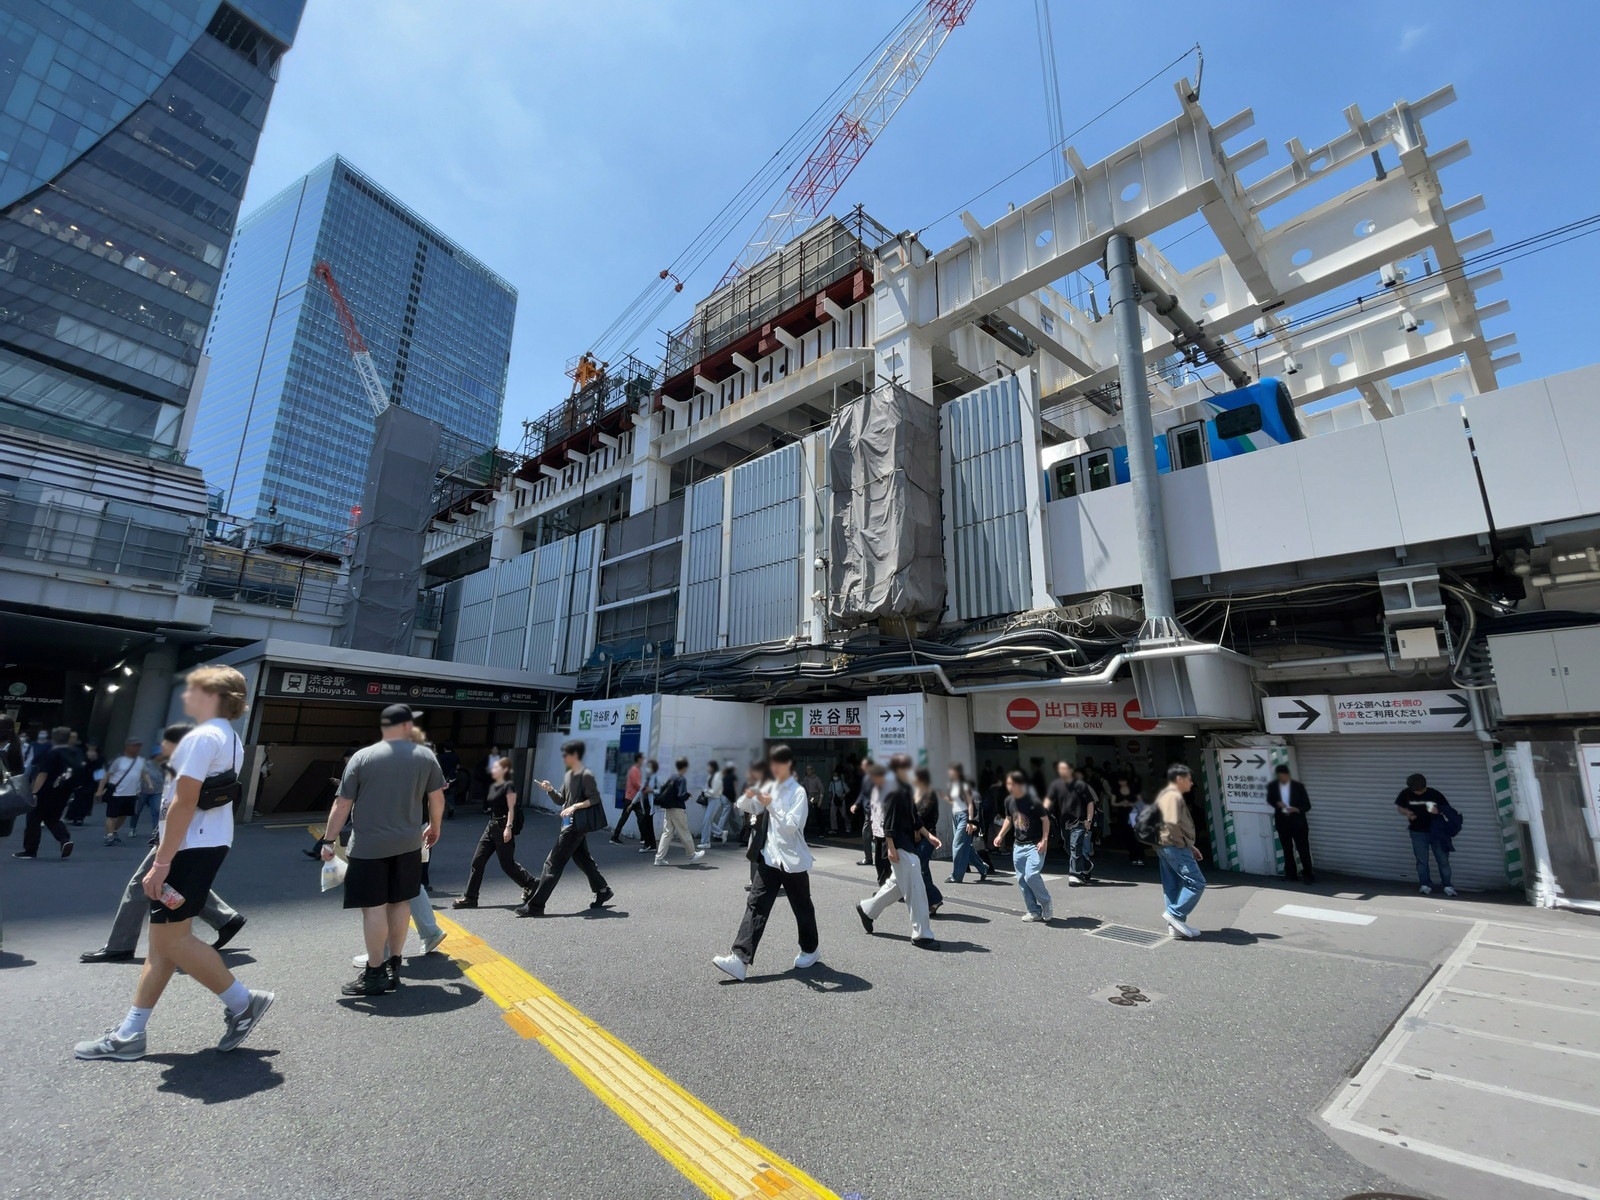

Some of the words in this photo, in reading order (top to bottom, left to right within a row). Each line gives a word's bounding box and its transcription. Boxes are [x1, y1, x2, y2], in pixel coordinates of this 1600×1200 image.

[309, 674, 346, 686] 渋谷駅
[308, 686, 341, 696] Shibuya
[342, 688, 358, 696] Sta.
[1045, 702, 1118, 718] 出口専用
[1339, 699, 1422, 710] ハチ公側へは右側の
[580, 711, 592, 724] JR
[593, 711, 610, 722] 渋谷駅
[630, 709, 639, 720] B7
[775, 711, 797, 728] JR
[809, 707, 860, 725] 渋谷駅
[1336, 709, 1427, 719] 歩道をご利用ください
[1063, 721, 1079, 729] EXIT
[1083, 721, 1103, 729] ONLY
[811, 726, 838, 736] 入口専用
[236, 1017, 252, 1031] N
[100, 1041, 115, 1053] N
